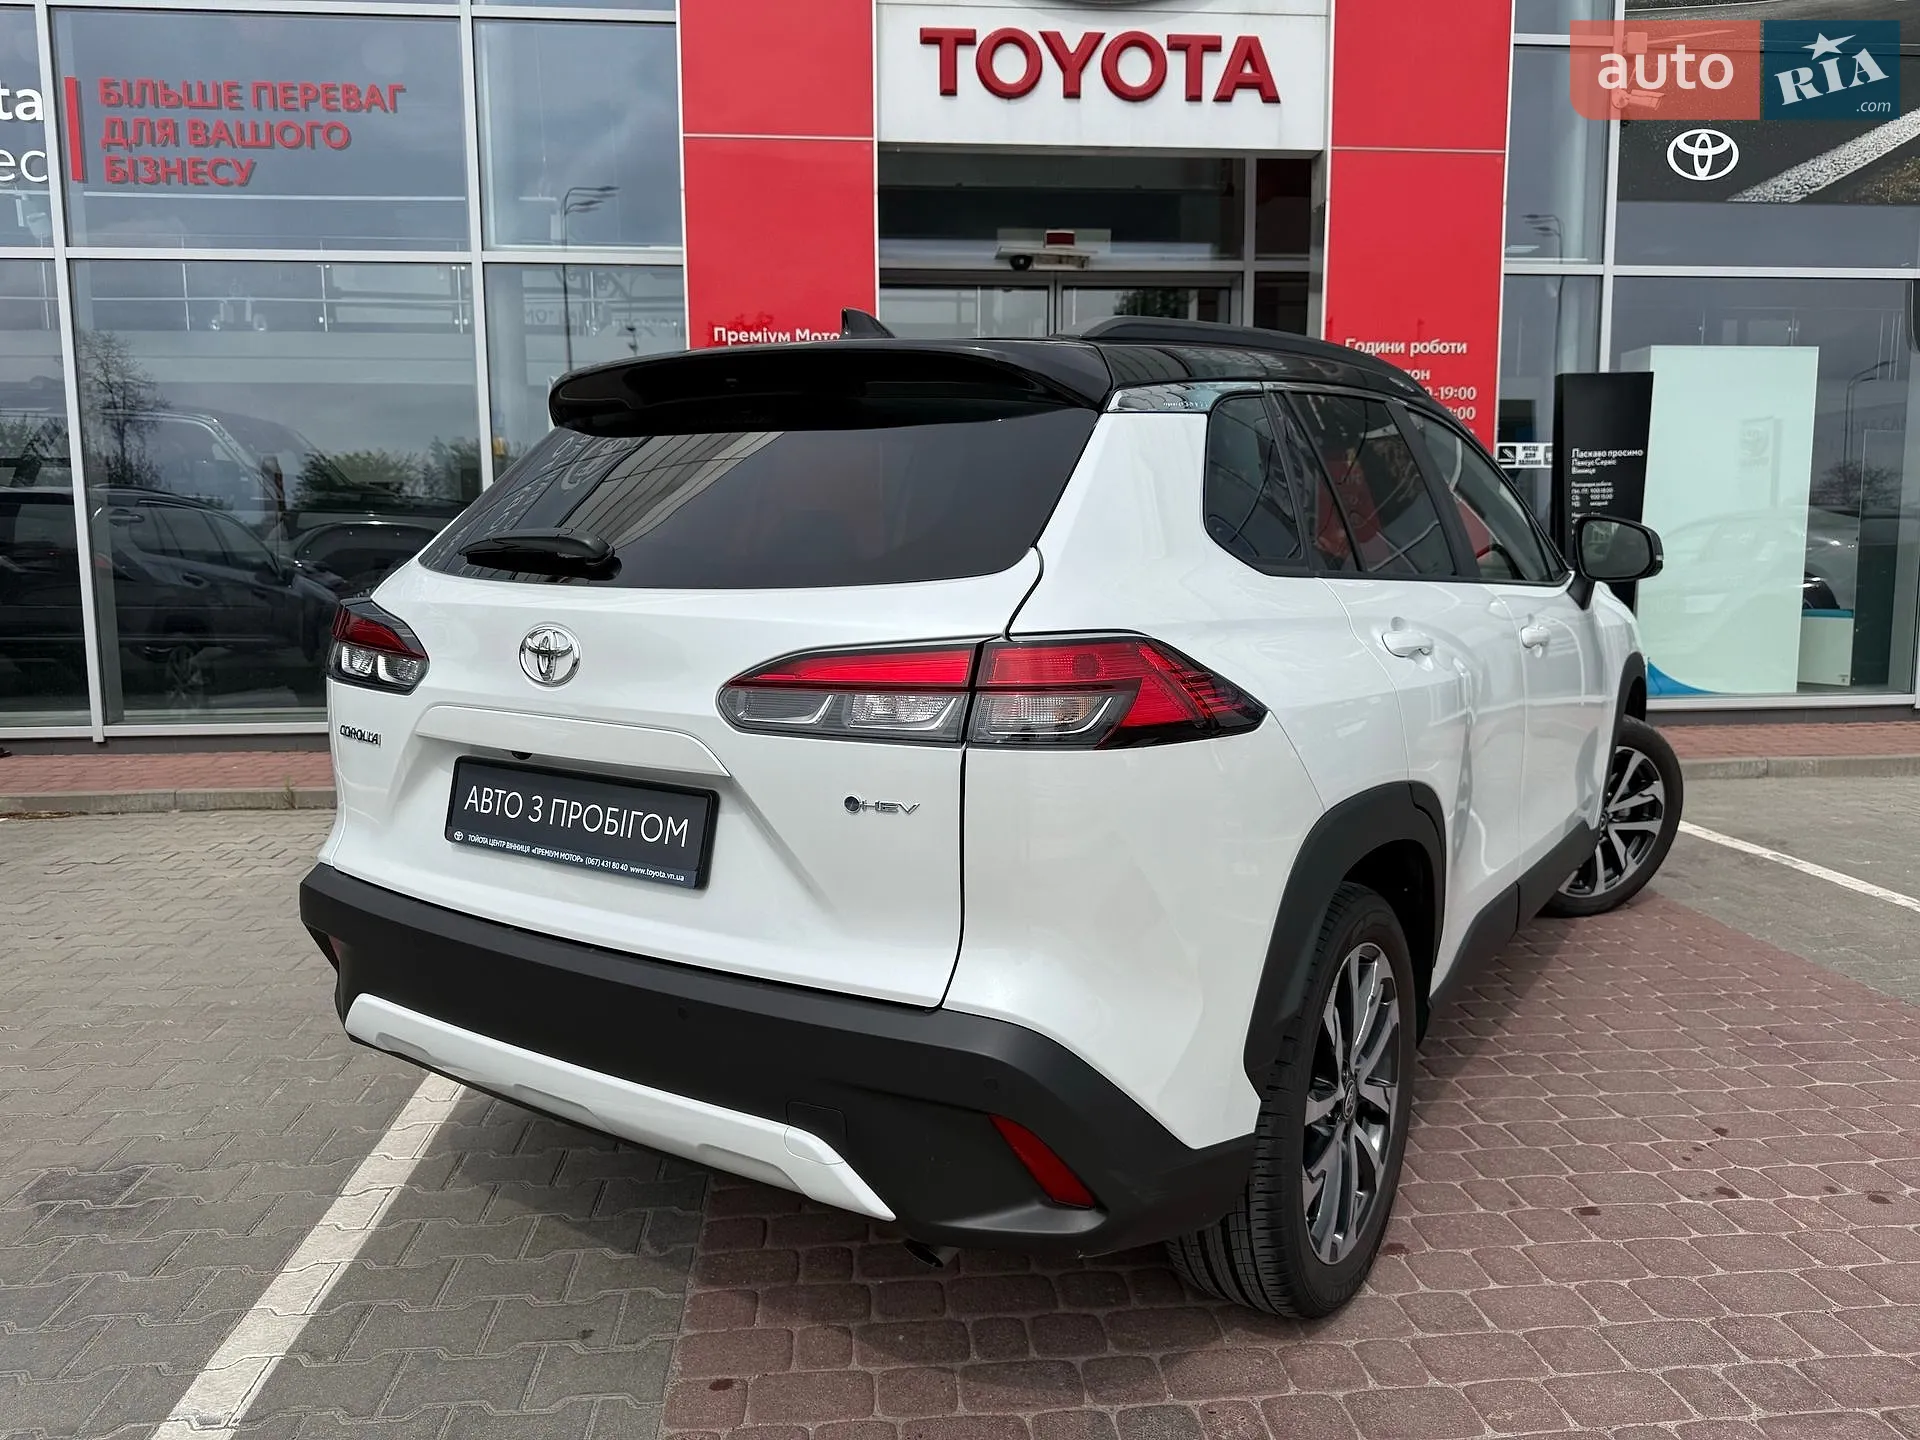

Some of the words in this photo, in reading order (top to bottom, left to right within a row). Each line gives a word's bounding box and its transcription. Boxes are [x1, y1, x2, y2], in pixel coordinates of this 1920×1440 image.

[920, 27, 1280, 103] TOYOTA
[98, 77, 243, 109] БІЛЬШЕ
[251, 81, 406, 113] ПЕРЕВАГ
[101, 117, 178, 150] ДЛЯ
[187, 120, 351, 150] ВАШОГО
[104, 156, 257, 186] БІЗНЕСУ
[713, 327, 790, 346] Преміум
[1344, 338, 1405, 355] Години
[1410, 338, 1467, 357] роботи
[1608, 449, 1644, 458] просимо
[340, 724, 379, 745] COROLLA
[464, 785, 523, 820] АВТО
[528, 795, 543, 824] З
[549, 798, 689, 848] ПРОБІГОМ
[860, 799, 921, 815] HEV
[468, 834, 489, 846] ТОЙОТА
[489, 839, 506, 849] ЦЕНТР
[506, 842, 531, 853] ВІННИЦЯ
[585, 856, 601, 868] (067)
[601, 860, 612, 869] 431
[612, 861, 620, 870] 80
[620, 863, 629, 872] 40
[630, 866, 685, 882] www.toyota.vn.ua
